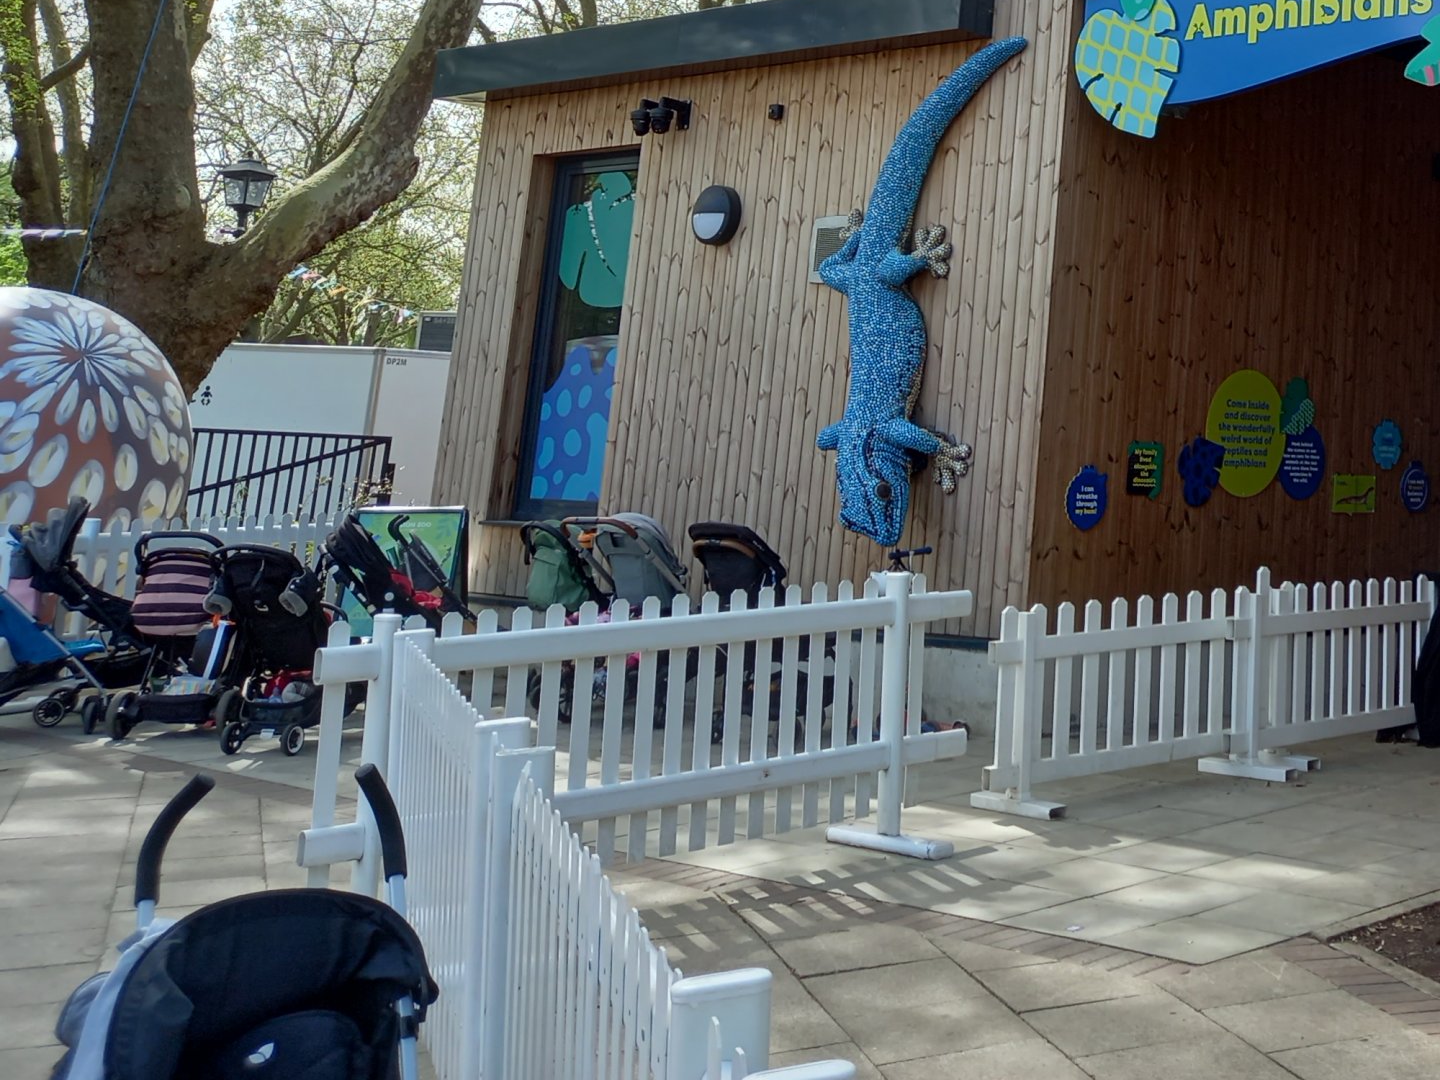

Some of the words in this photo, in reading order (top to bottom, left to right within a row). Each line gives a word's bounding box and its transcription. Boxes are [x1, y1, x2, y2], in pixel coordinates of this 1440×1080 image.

[1226, 399, 1247, 409] Come
[1248, 400, 1270, 410] inside
[1224, 411, 1239, 420] and
[1240, 411, 1271, 422] discover
[1218, 422, 1232, 431] the
[1232, 423, 1275, 435] wonderfully
[1221, 434, 1242, 443] weird
[1242, 435, 1263, 444] world
[1264, 436, 1272, 445] of
[1225, 447, 1252, 457] reptiles
[1253, 447, 1268, 456] and
[1223, 458, 1267, 469] amphibians
[1076, 492, 1098, 500] breathe
[1075, 500, 1098, 509] through
